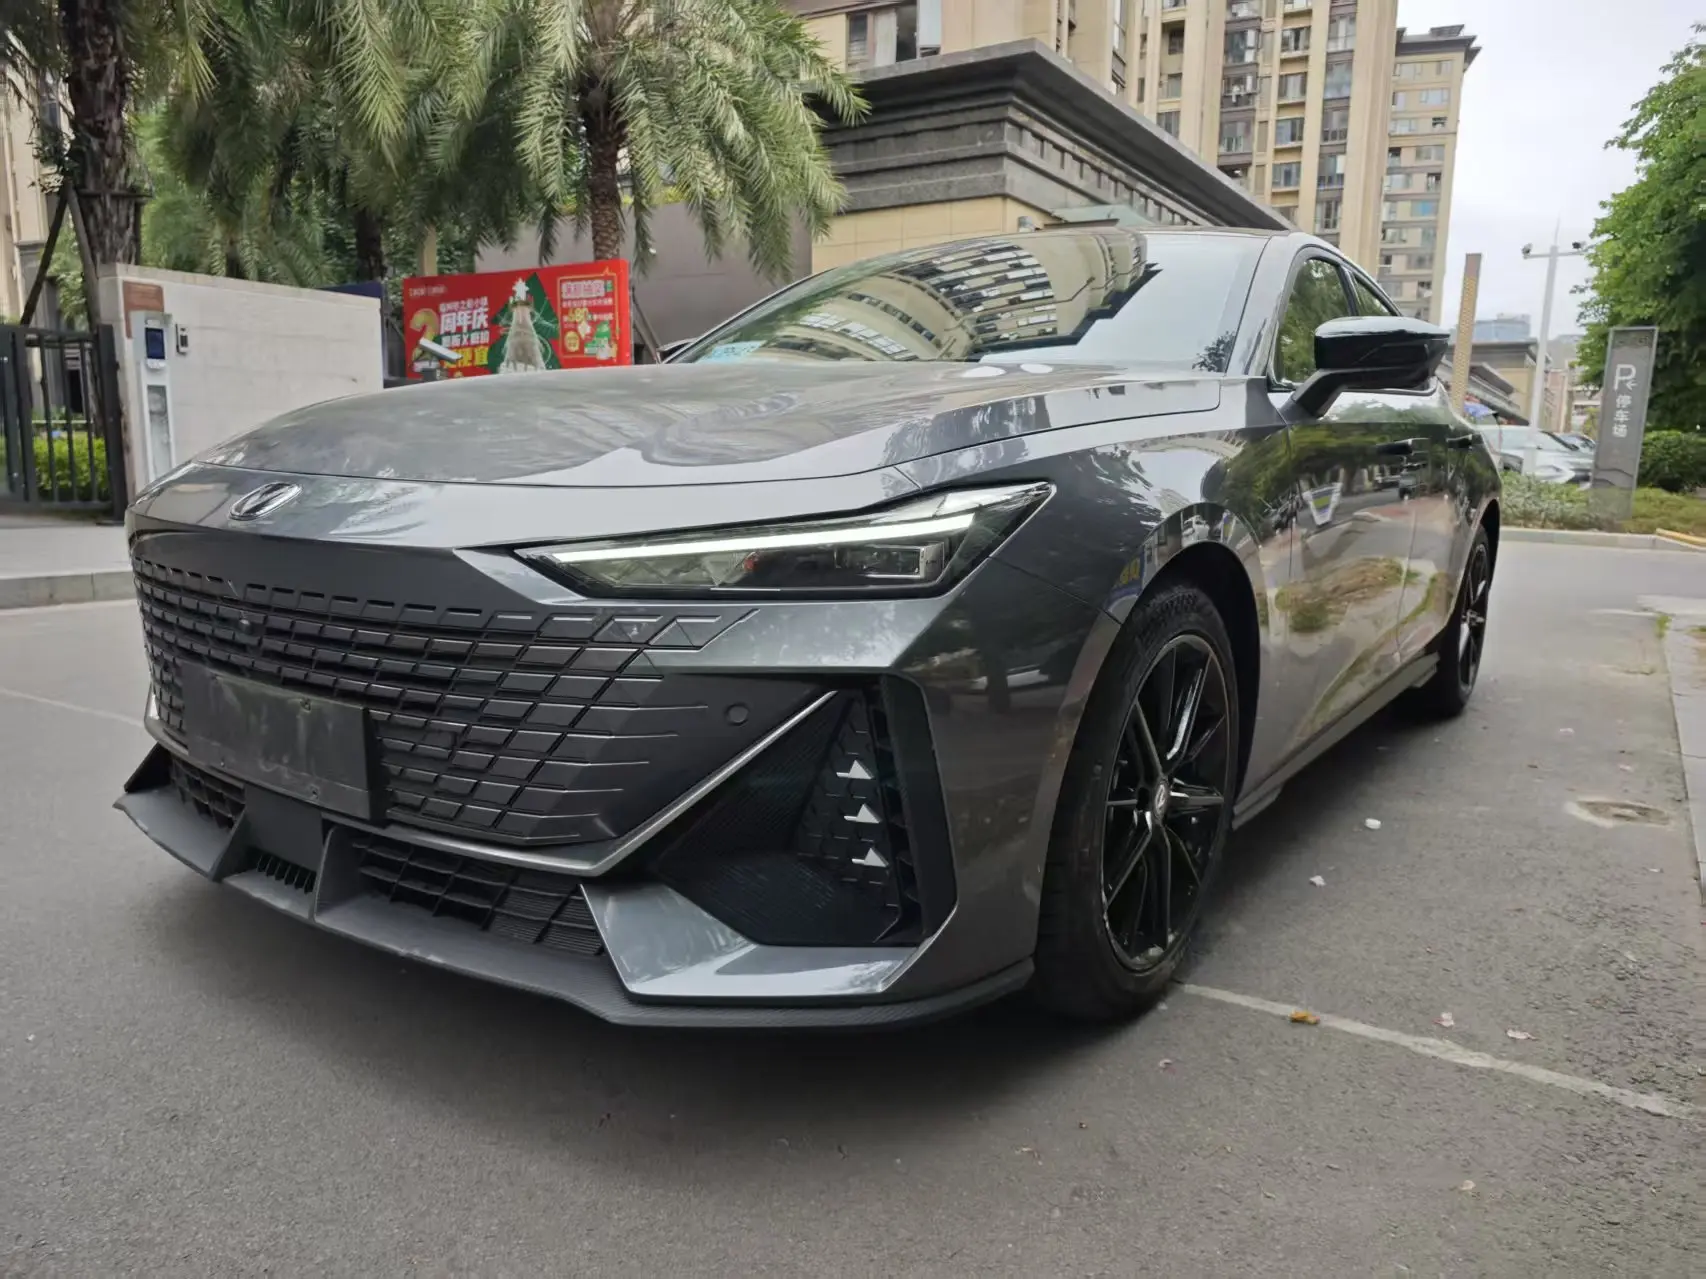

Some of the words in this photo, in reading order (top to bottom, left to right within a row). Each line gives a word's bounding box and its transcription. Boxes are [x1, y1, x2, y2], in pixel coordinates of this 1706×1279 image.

[440, 307, 489, 334] 周年庆
[1613, 364, 1636, 391] P
[1611, 394, 1632, 438] 停车场
